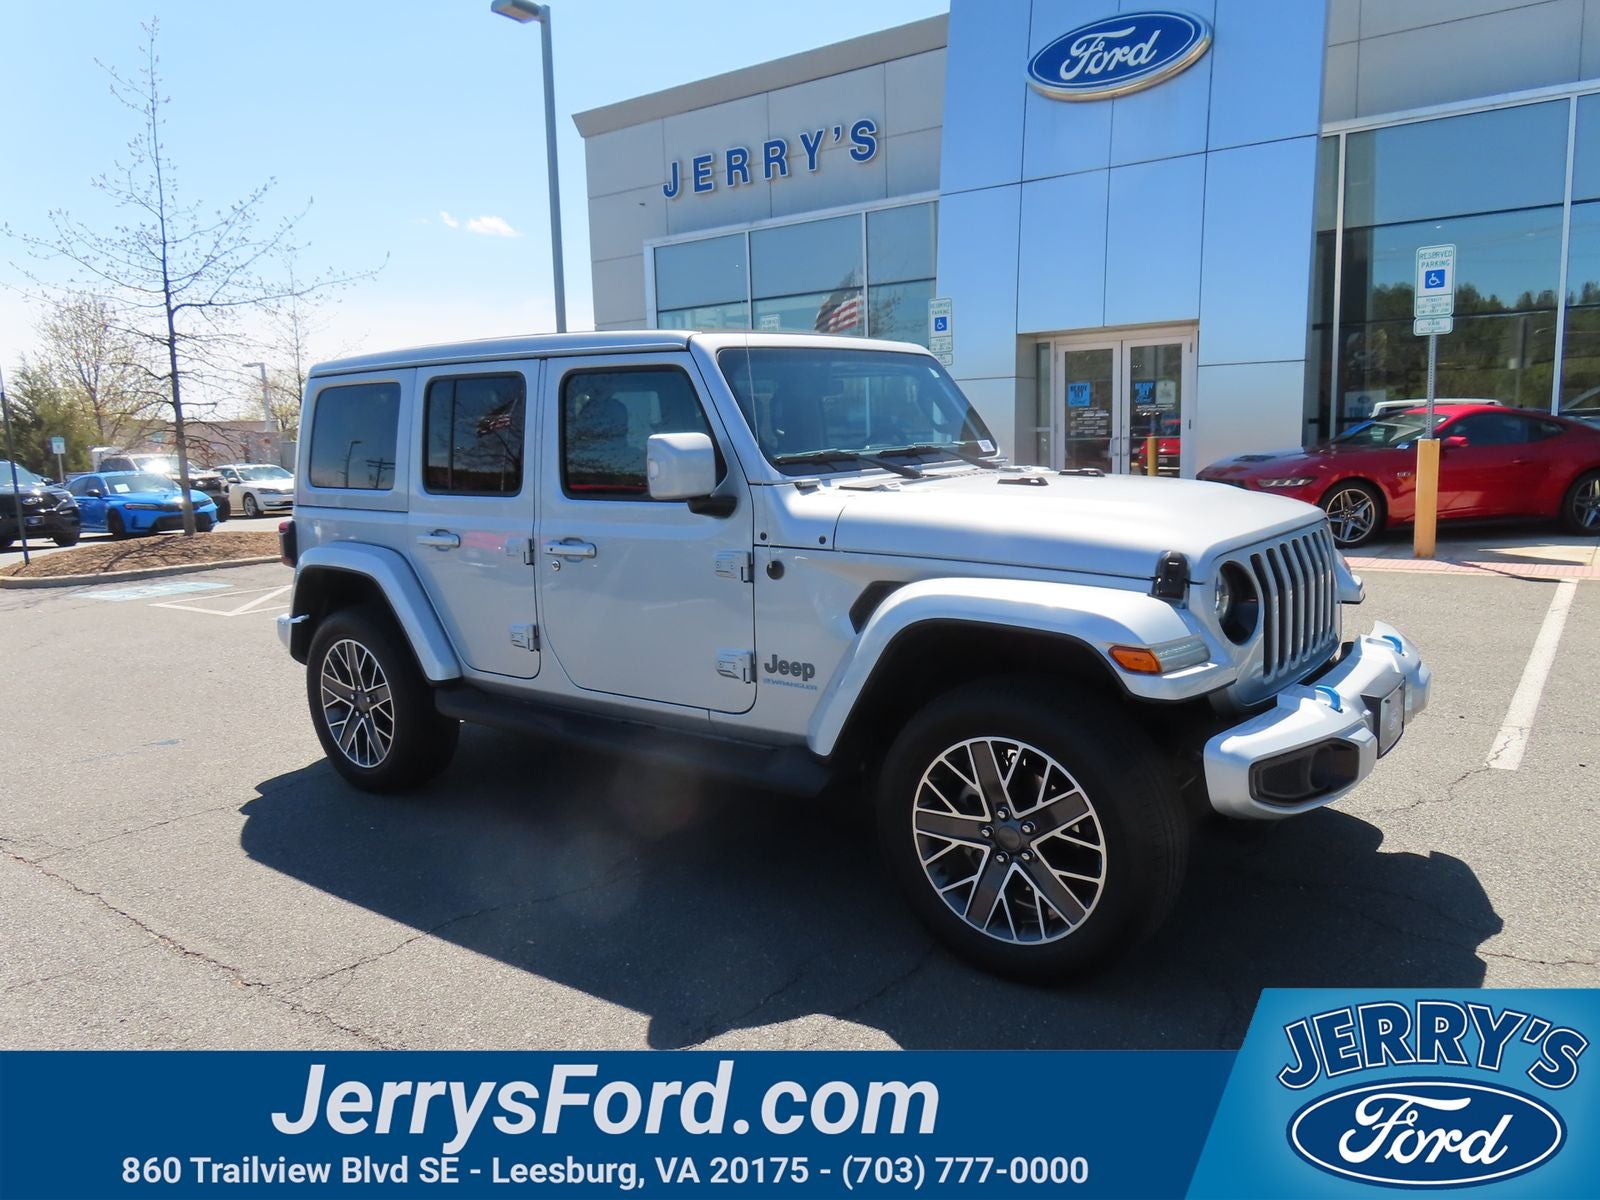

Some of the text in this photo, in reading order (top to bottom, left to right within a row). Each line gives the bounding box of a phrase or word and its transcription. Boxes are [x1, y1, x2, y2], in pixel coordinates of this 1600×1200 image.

[1059, 26, 1162, 80] Ford
[662, 118, 878, 198] JERRY'S
[1420, 249, 1453, 260] RESERVED
[1421, 259, 1450, 268] PARKING
[764, 654, 815, 681] Jeep
